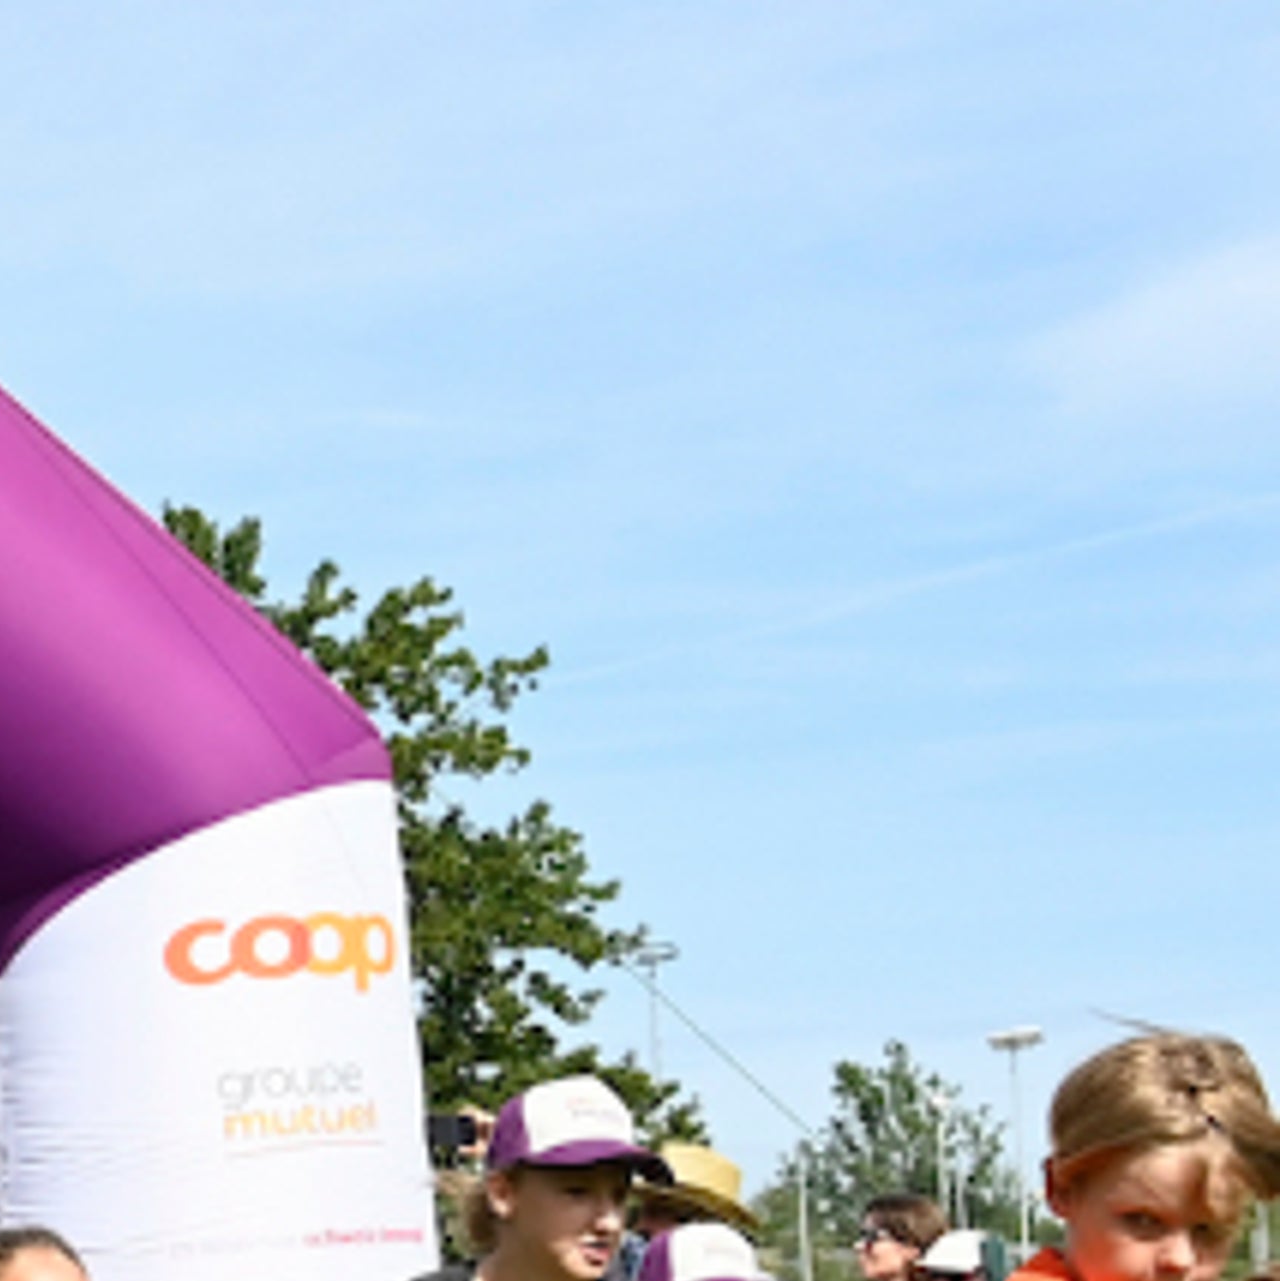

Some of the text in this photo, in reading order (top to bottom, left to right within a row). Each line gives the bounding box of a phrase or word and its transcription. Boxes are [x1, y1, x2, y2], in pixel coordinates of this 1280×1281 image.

[164, 914, 395, 993] coop
[216, 1063, 364, 1110] groupe
[224, 1100, 377, 1141] mutuel
